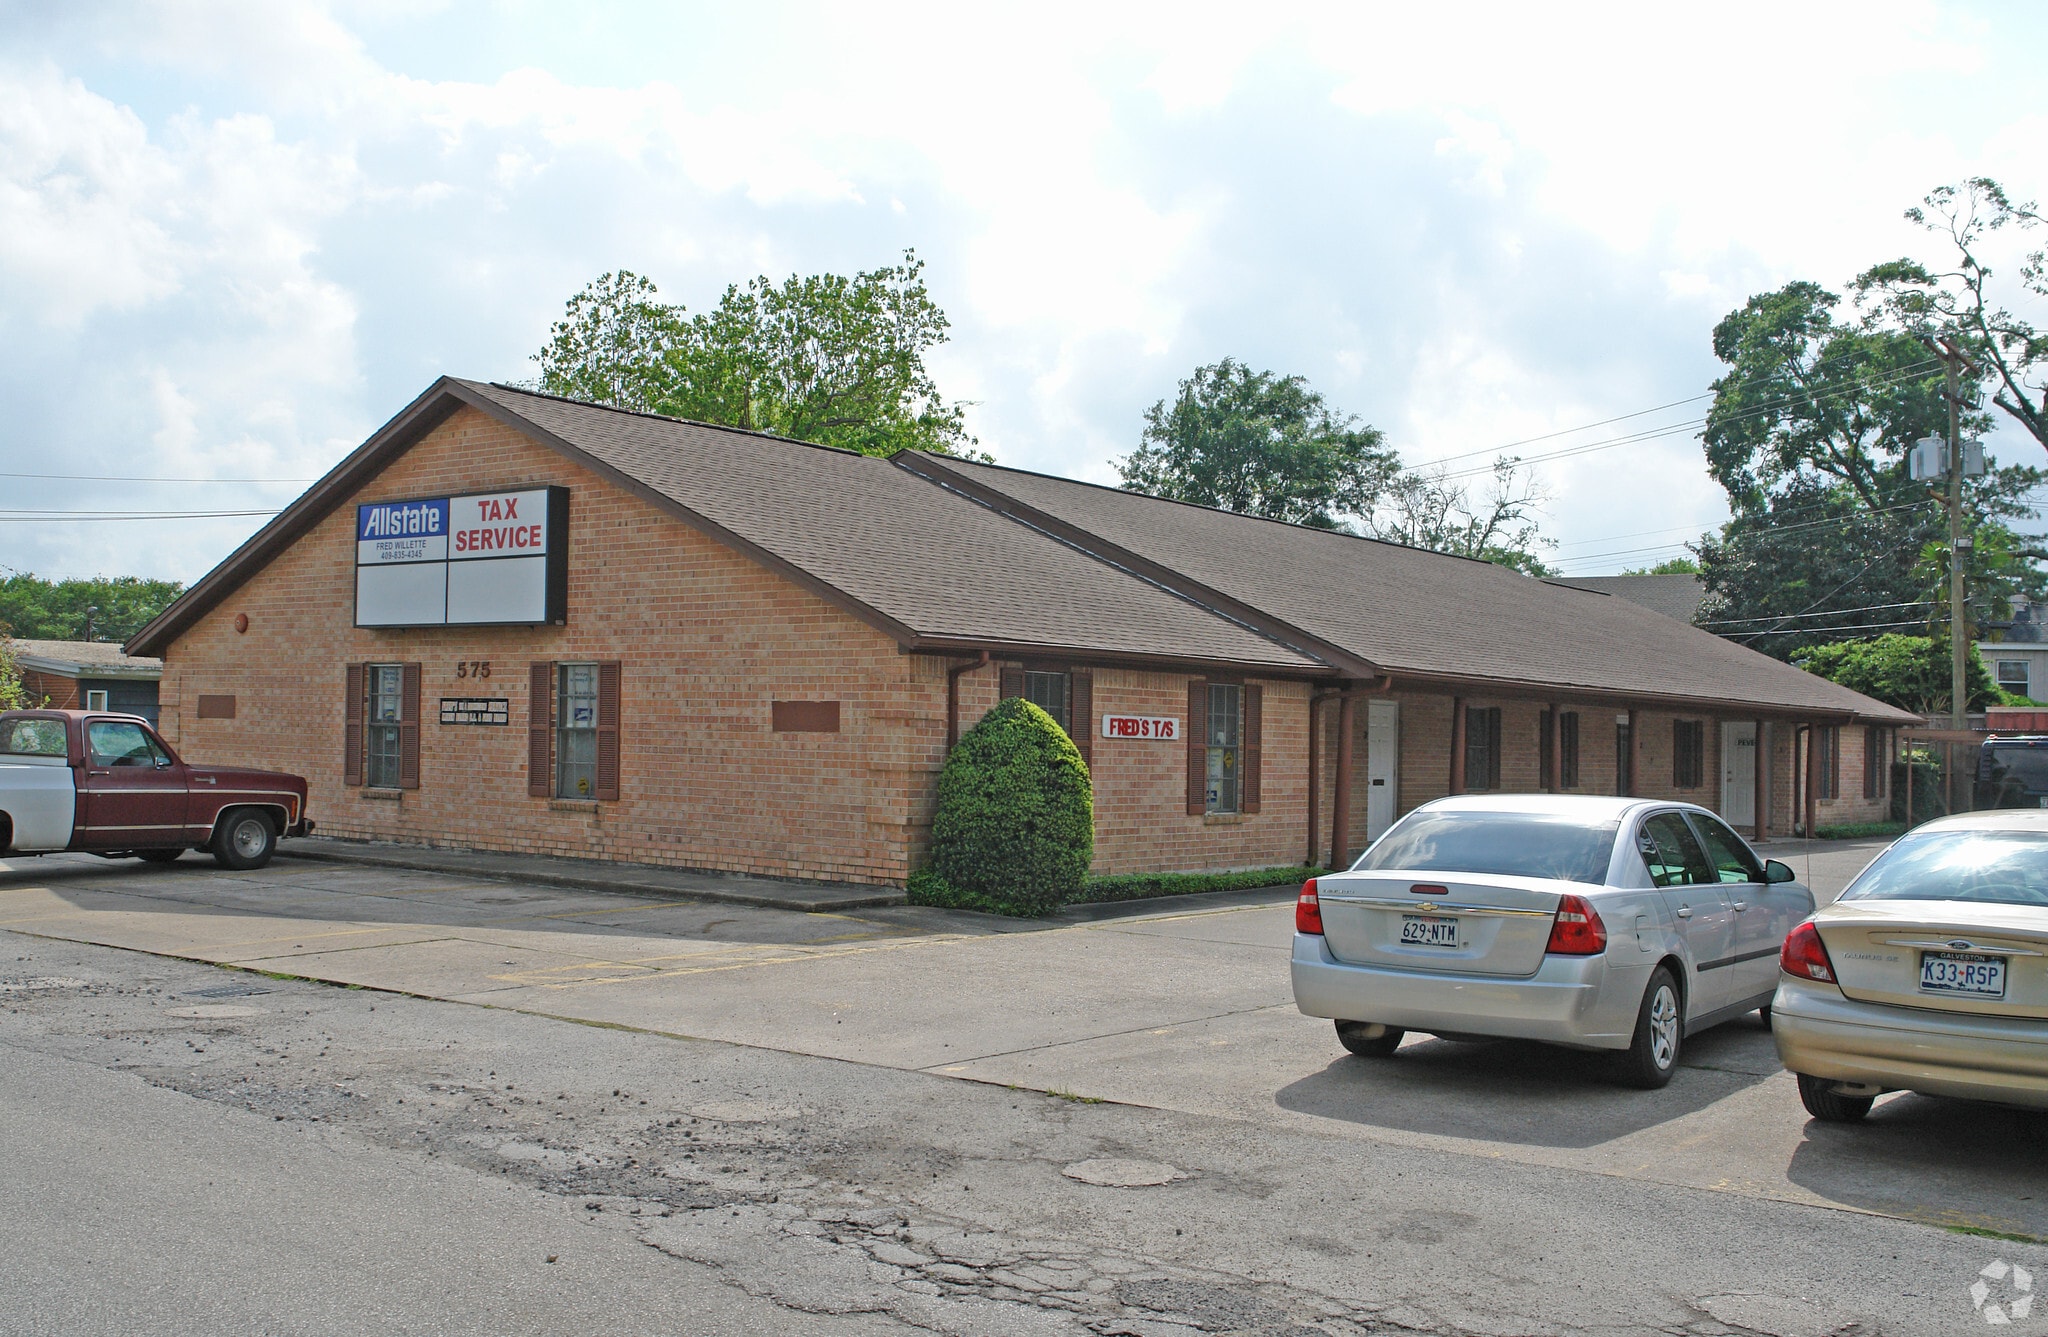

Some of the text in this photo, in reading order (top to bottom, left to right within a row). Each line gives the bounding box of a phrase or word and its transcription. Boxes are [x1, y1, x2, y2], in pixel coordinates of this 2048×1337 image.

[478, 498, 518, 521] TAX
[364, 504, 440, 536] Allstate
[376, 540, 427, 550] FRED WILLETTE
[455, 525, 542, 551] SERVICE
[457, 661, 491, 678] 575
[1110, 718, 1174, 737] FRED'S T/S
[1940, 952, 1985, 961] GALVESTON
